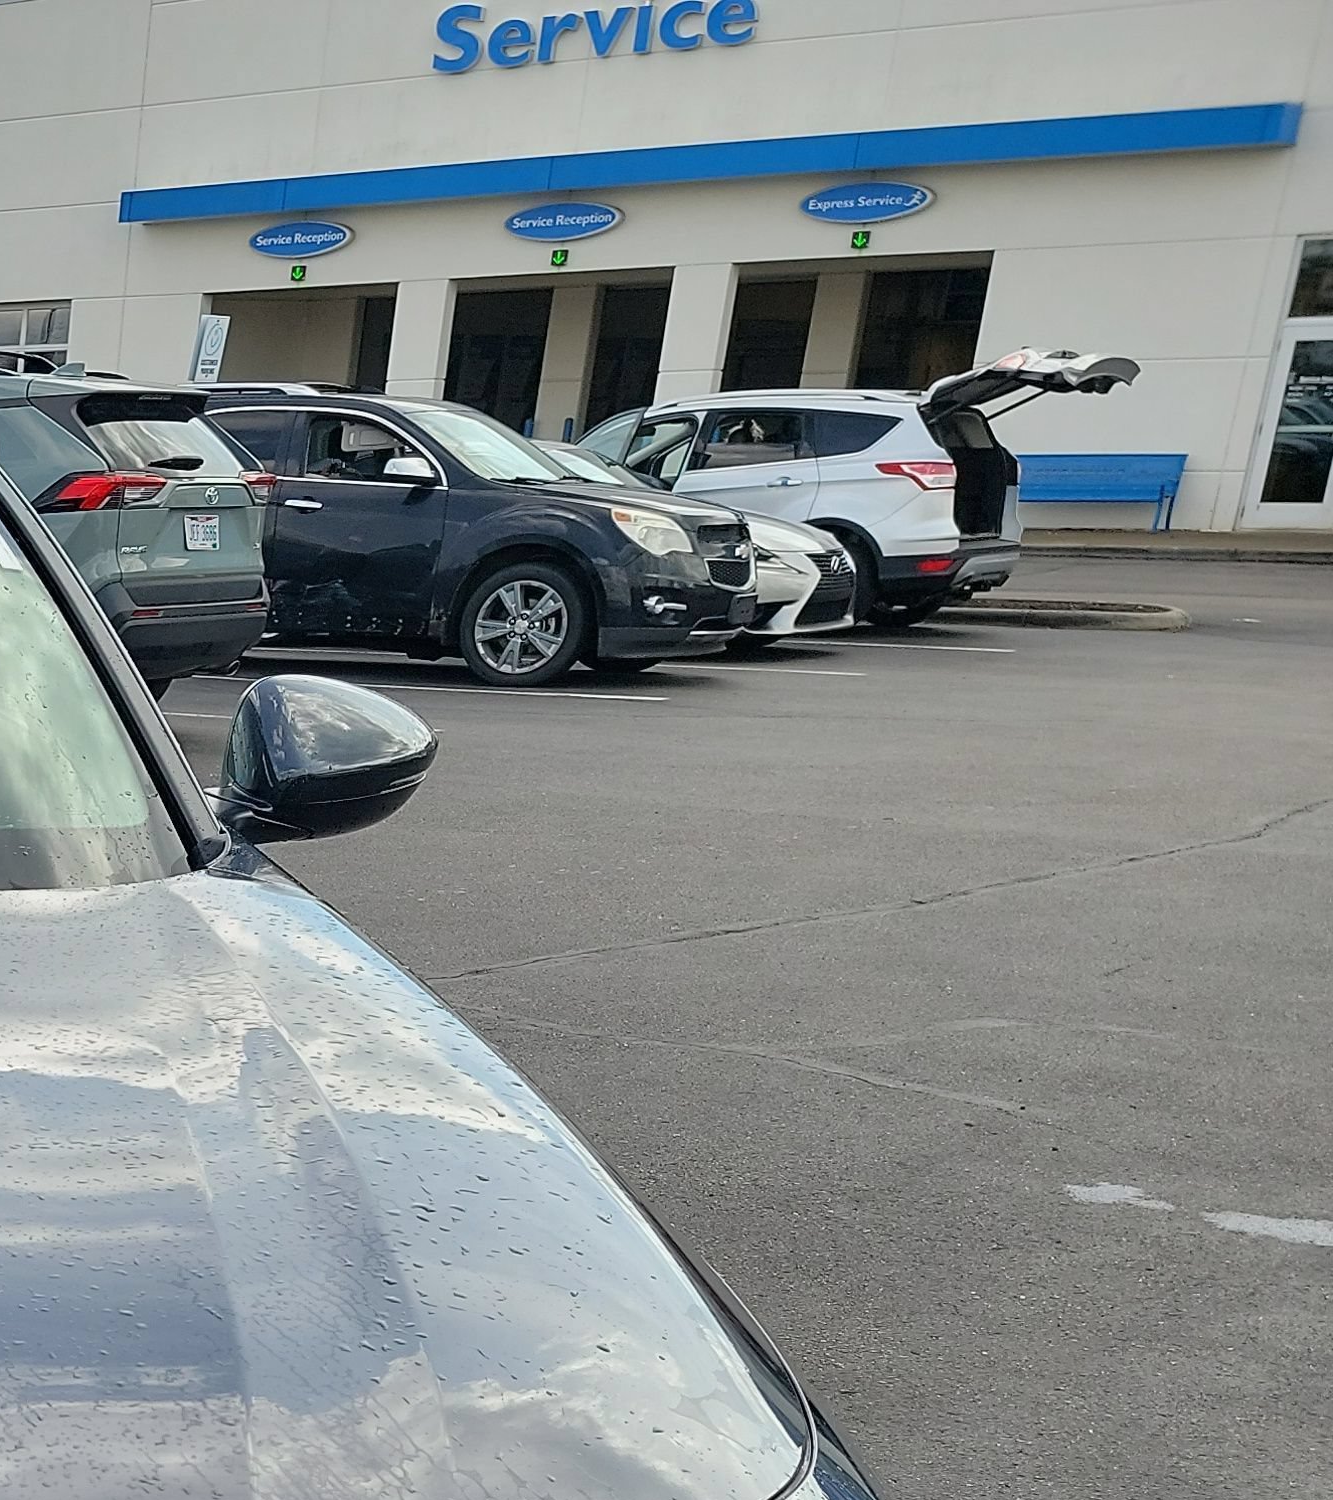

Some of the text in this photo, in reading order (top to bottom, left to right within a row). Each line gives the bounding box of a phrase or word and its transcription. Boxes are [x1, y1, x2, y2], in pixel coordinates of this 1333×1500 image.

[432, 0, 758, 75] Service
[808, 195, 903, 212] Express Service
[512, 212, 612, 229] Service Reception
[256, 231, 344, 246] Service Reception
